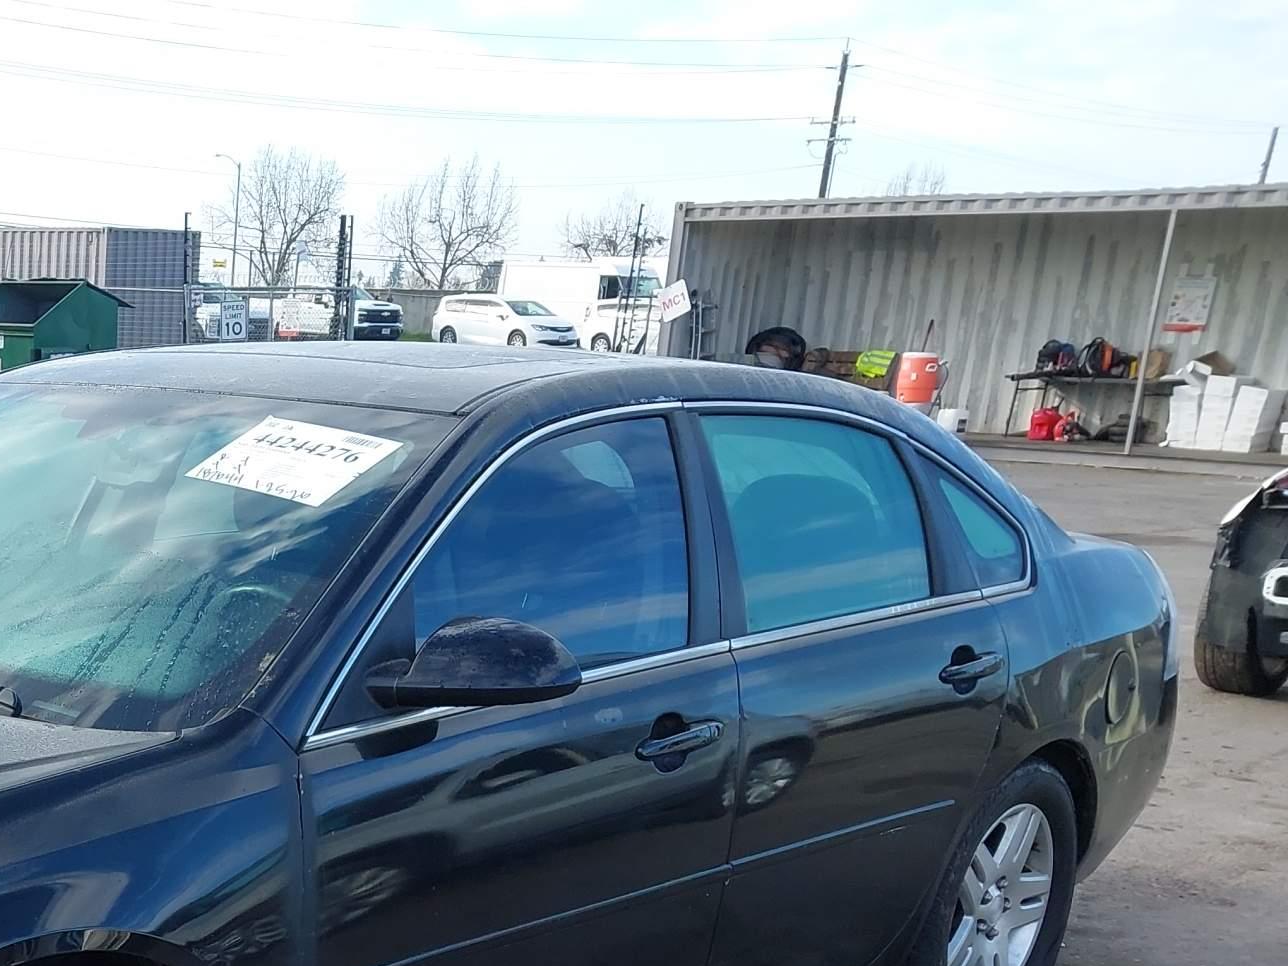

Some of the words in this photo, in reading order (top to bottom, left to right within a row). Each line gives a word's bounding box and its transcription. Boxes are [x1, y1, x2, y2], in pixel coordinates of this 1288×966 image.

[223, 304, 245, 312] SPEED
[662, 292, 686, 311] MC1
[224, 312, 242, 320] LIMIT
[225, 321, 243, 337] 10
[252, 433, 363, 464] 44244276
